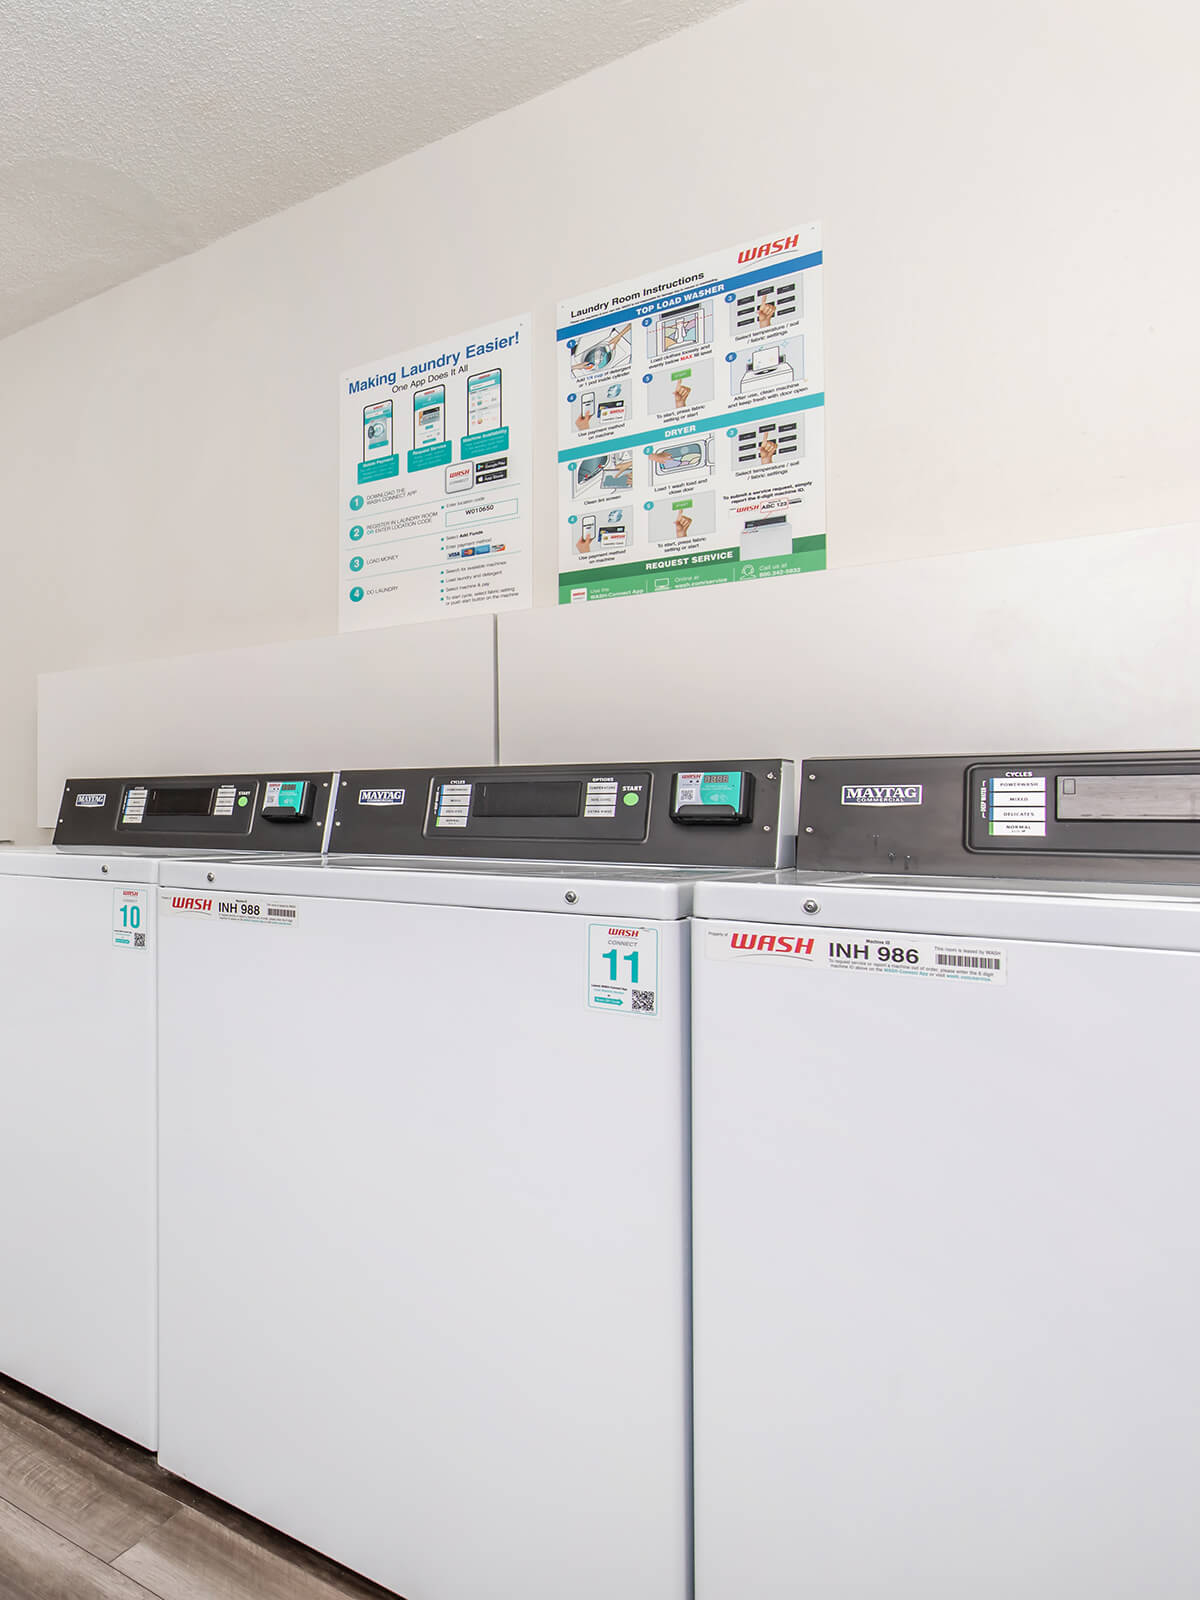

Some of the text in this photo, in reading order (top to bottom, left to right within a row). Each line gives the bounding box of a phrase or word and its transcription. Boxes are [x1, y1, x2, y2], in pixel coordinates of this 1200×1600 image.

[738, 234, 799, 264] WASH
[571, 272, 704, 318] Laundry Room Instructions
[636, 284, 725, 315] TOP LOAD WASHER
[349, 331, 519, 394] Making Laundry Easier!
[610, 365, 631, 374] detergent
[392, 383, 407, 393] One
[410, 378, 425, 388] App
[428, 373, 448, 383] Does
[458, 364, 468, 374] All
[588, 427, 606, 436] payment
[665, 425, 696, 437] DRYER
[450, 469, 469, 478] WASH
[466, 505, 494, 515] W010650
[589, 551, 607, 559] payment
[646, 552, 733, 570] REQUEST SERVICE
[362, 792, 401, 800] MAYTAG
[847, 788, 916, 798] MAYTAG
[172, 896, 212, 911] WASH
[219, 902, 237, 913] INH
[241, 904, 260, 916] 988
[120, 905, 140, 928] 10
[608, 928, 639, 937] WASH
[730, 933, 918, 964] WASH INH 986
[602, 949, 638, 983] 11
